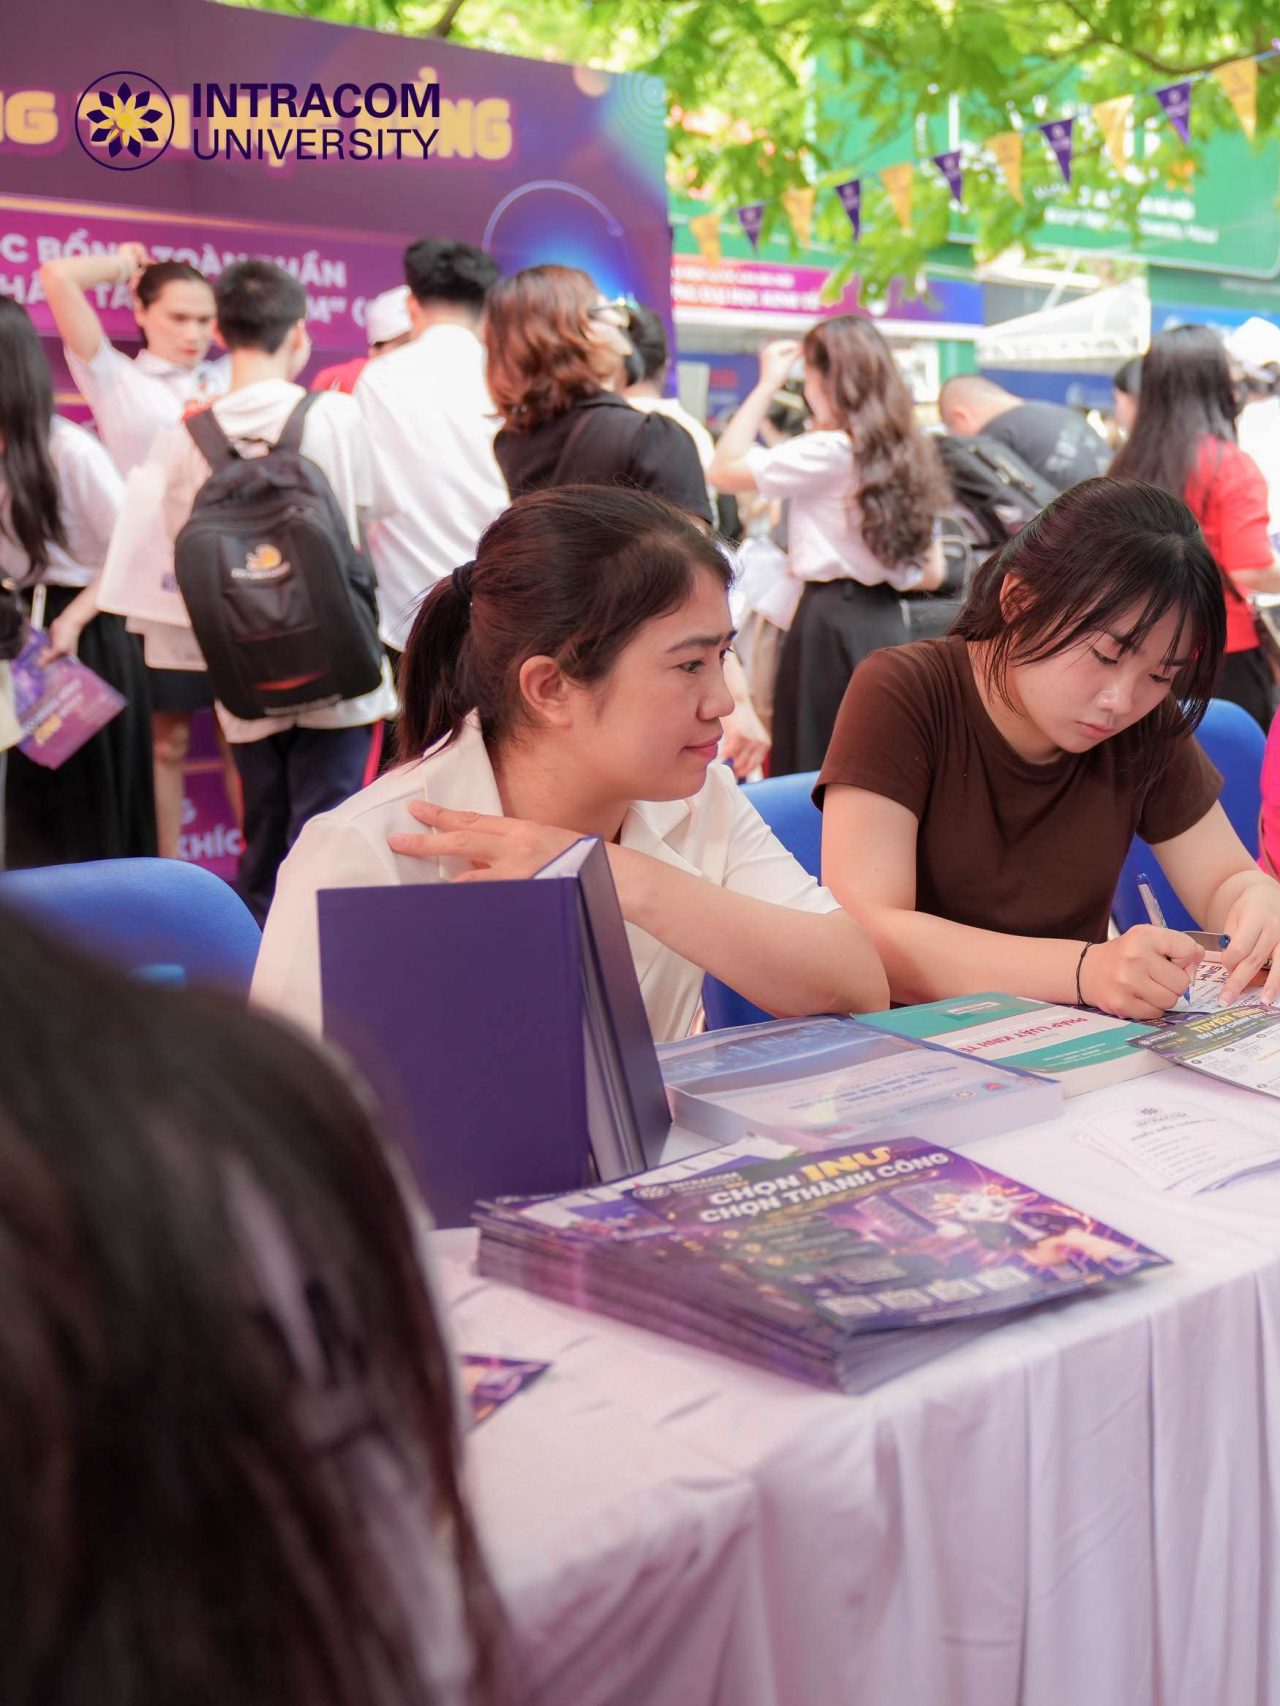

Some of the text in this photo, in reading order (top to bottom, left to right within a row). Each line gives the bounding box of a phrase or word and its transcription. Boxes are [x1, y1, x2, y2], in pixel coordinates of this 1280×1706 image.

[699, 1198, 781, 1224] CHỌN
[876, 1151, 950, 1178] CÔNG
[709, 1174, 801, 1206] CHỌN
